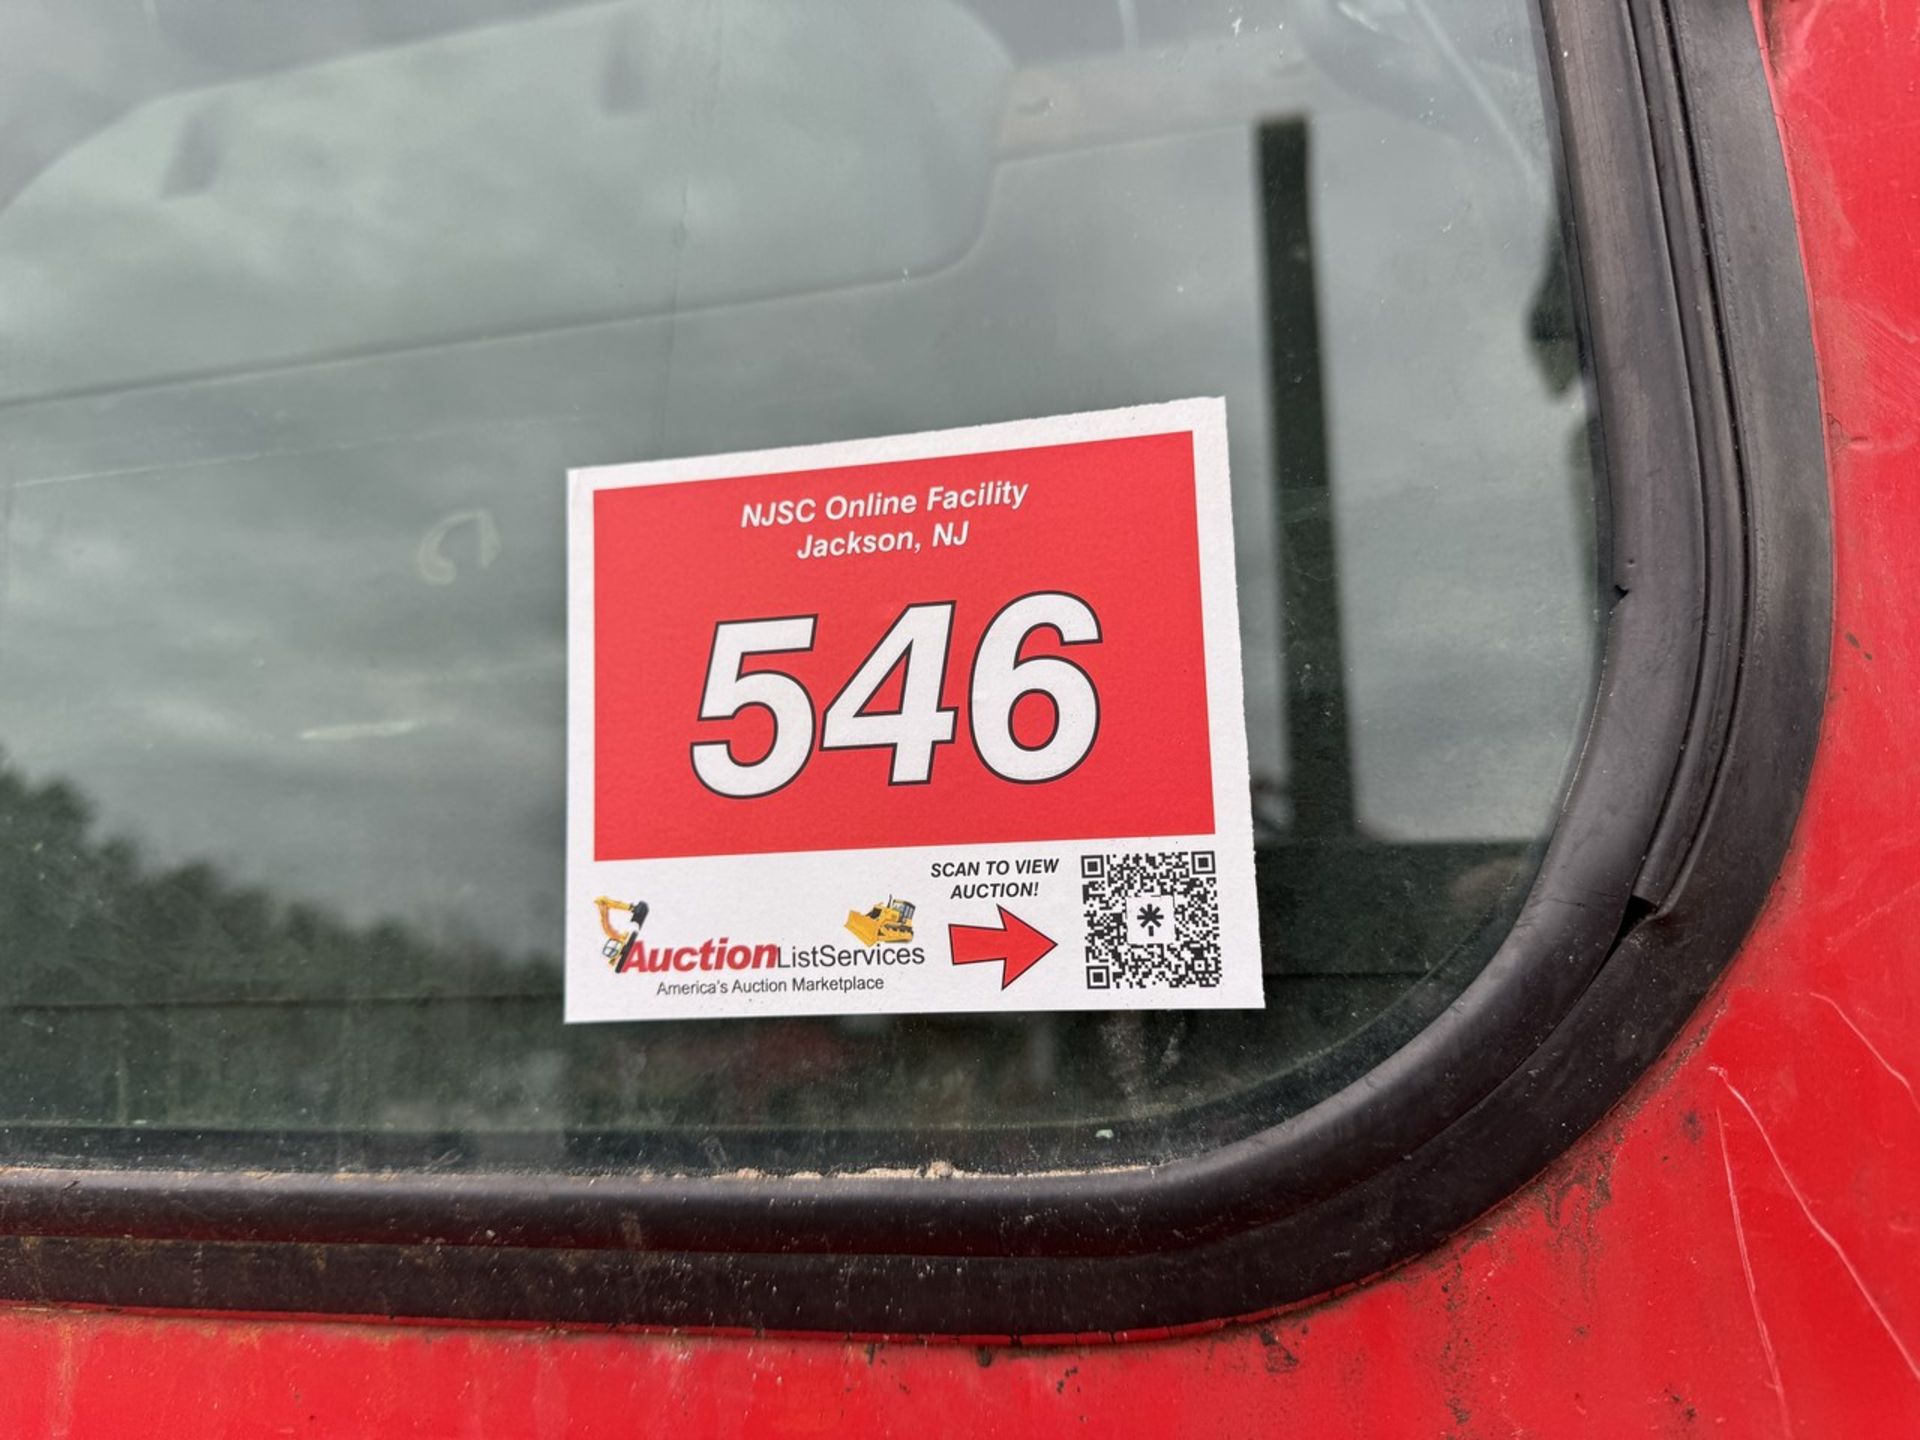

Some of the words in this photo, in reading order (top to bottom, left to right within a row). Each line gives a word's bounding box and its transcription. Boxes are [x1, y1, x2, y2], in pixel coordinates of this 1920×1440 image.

[741, 498, 816, 528] NJSC
[825, 491, 917, 520] Online
[927, 480, 1029, 511] Facility
[796, 529, 922, 559] Jackson,
[932, 521, 970, 547] NJ
[690, 590, 1103, 800] 546
[930, 861, 980, 878] SCAN
[986, 859, 1010, 875] TO
[1015, 858, 1060, 874] VIEW
[950, 881, 1040, 900] AUCTION!
[656, 979, 729, 996] America's
[732, 978, 788, 994] Auction
[792, 976, 885, 993] Marketplace
